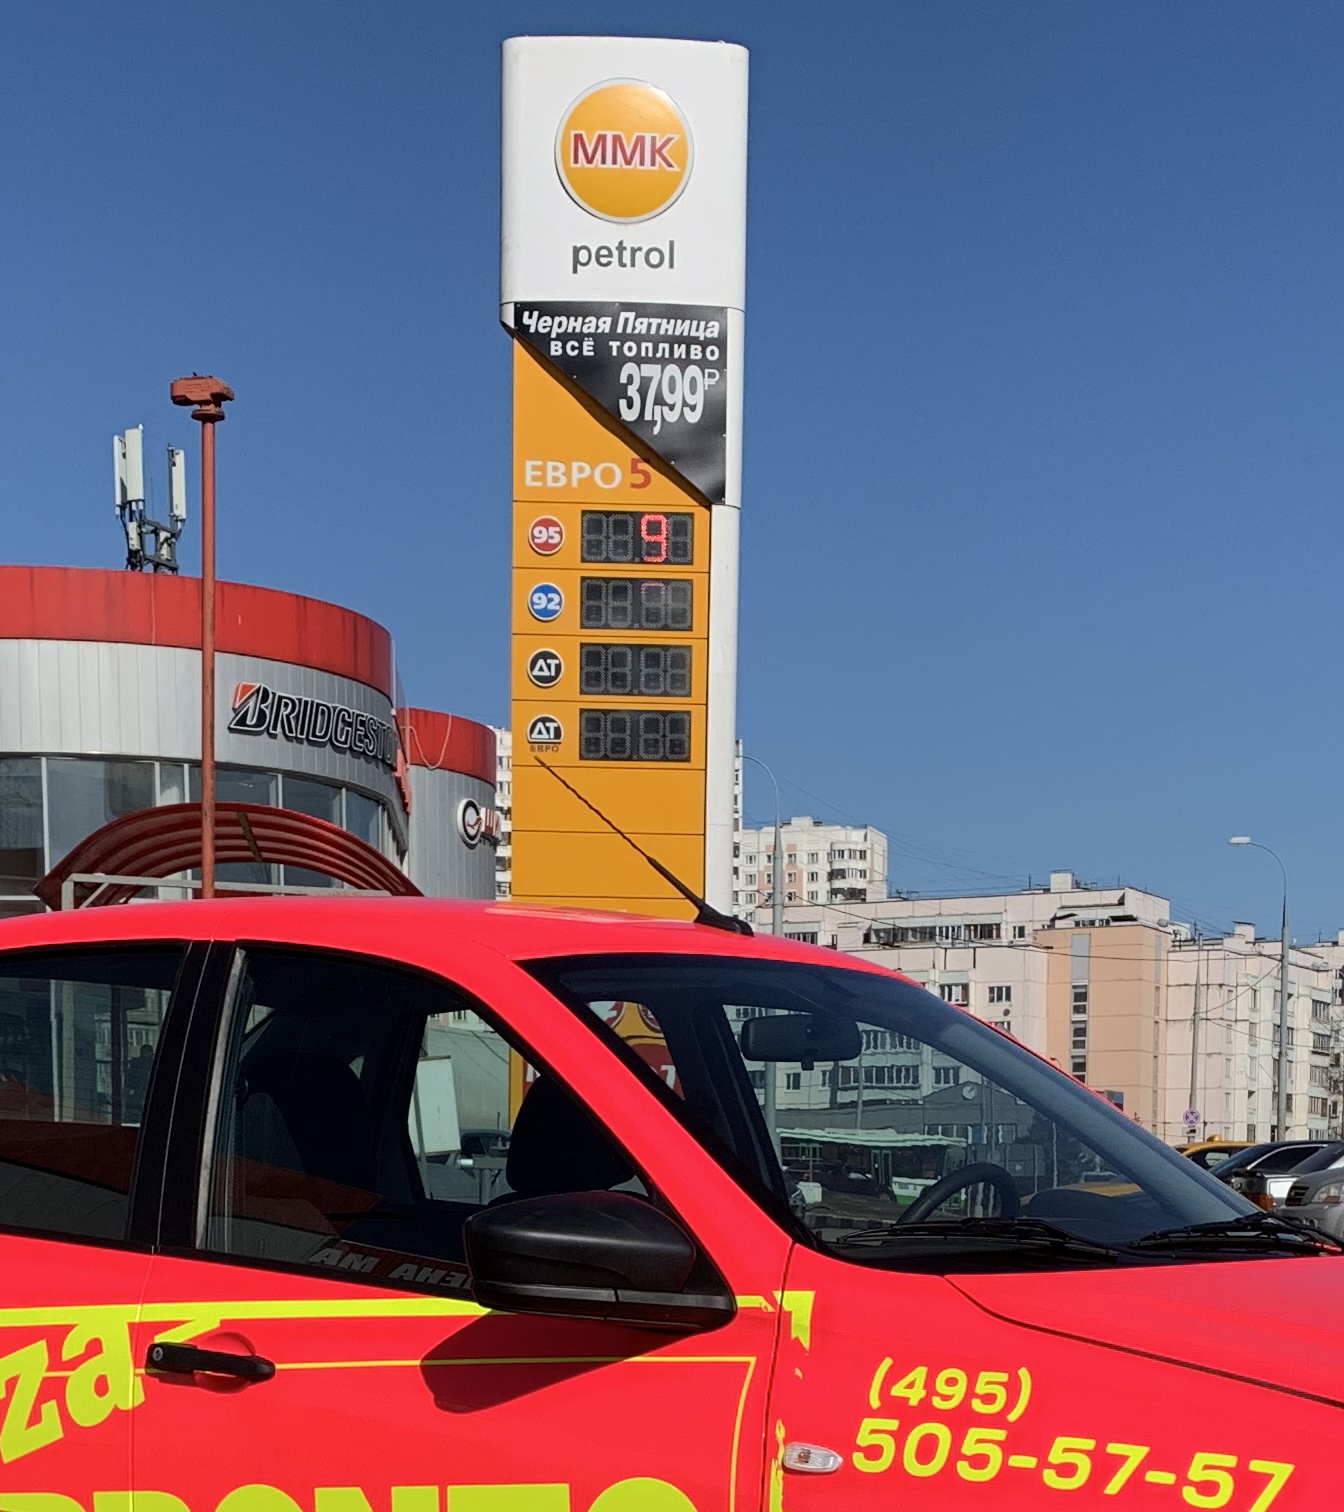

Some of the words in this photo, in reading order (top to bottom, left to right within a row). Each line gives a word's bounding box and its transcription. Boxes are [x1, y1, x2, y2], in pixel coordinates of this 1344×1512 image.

[571, 240, 675, 274] petrol
[522, 310, 611, 337] Черная
[616, 312, 720, 340] Пятница
[550, 337, 595, 357] ВСЁ
[608, 341, 720, 361] ТОПЛИВО
[524, 459, 623, 488] ЕВРО
[629, 457, 653, 489] 5
[532, 525, 561, 545] 95
[532, 591, 561, 611] 92
[869, 1357, 1032, 1422] (495)
